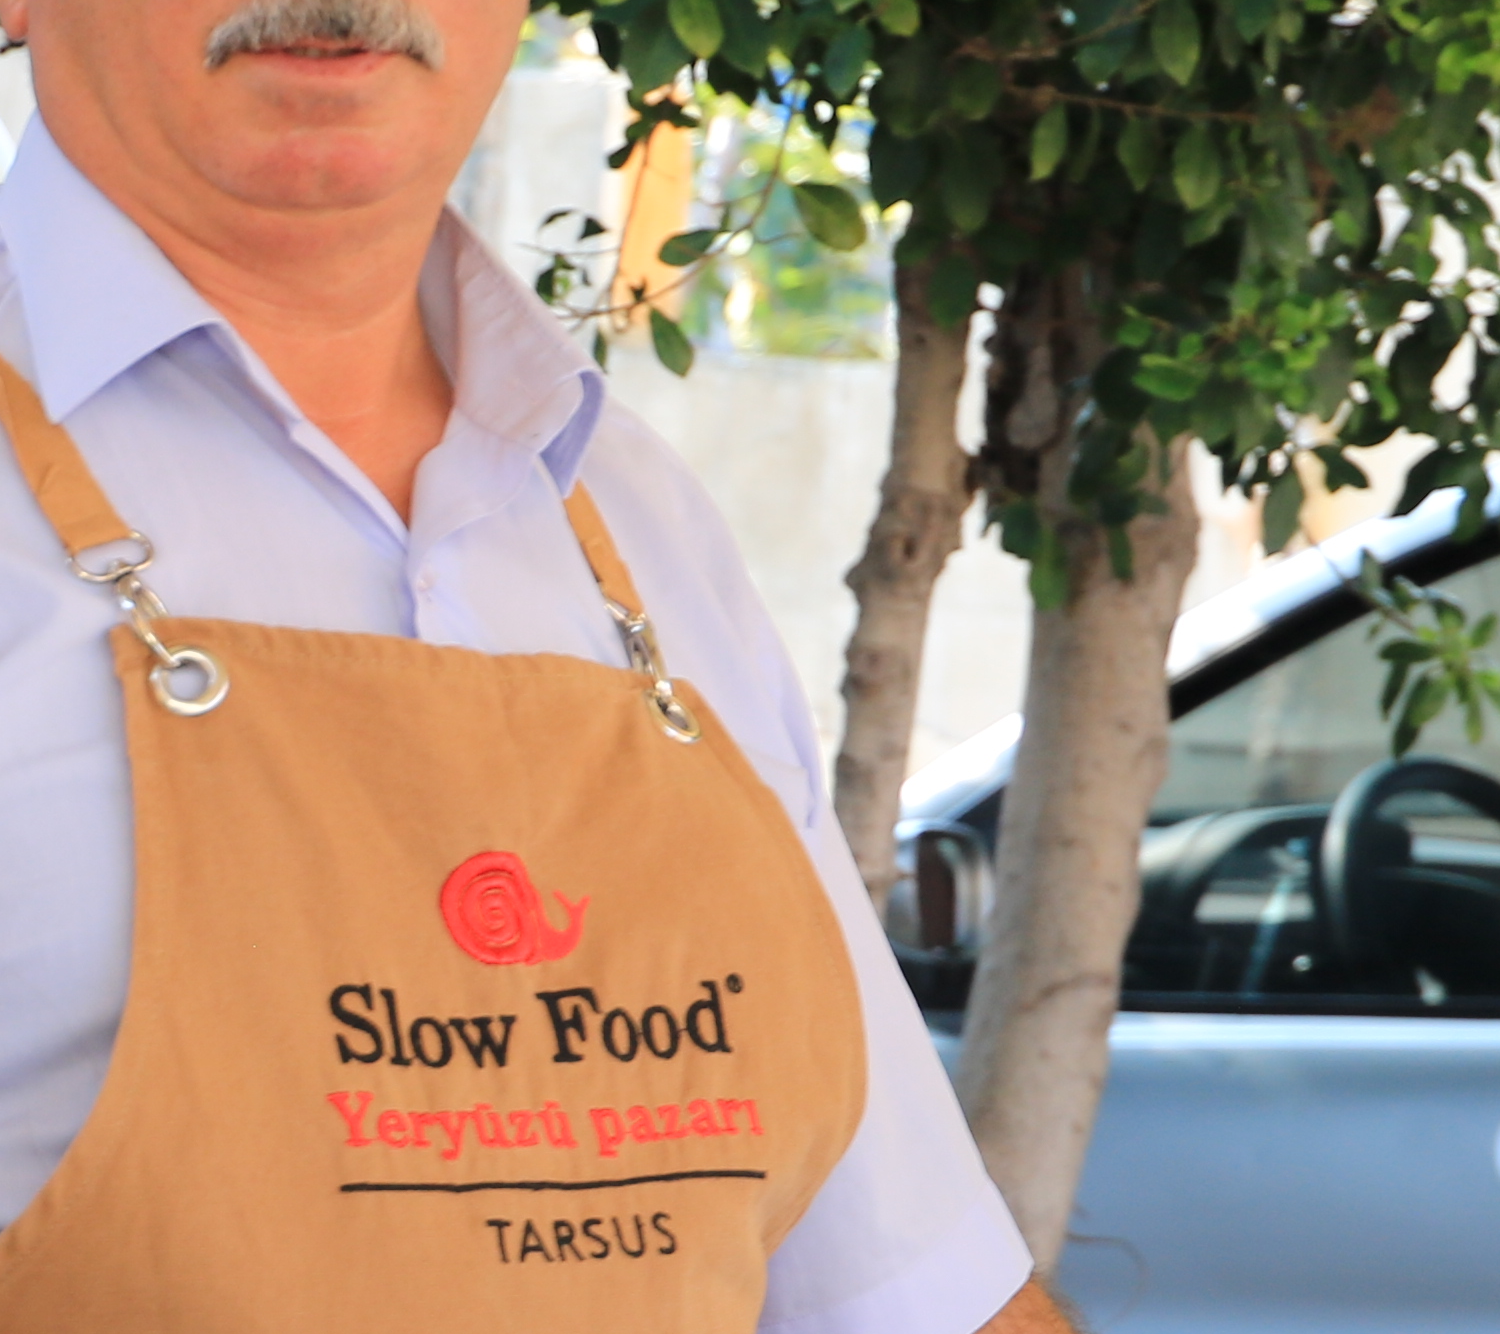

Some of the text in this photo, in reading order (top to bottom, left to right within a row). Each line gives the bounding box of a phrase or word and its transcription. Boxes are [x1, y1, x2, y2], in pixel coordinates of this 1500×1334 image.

[328, 983, 517, 1068] Slow
[326, 1091, 764, 1161] Yeryüzü pazarı
[486, 1211, 678, 1264] TARSUS
